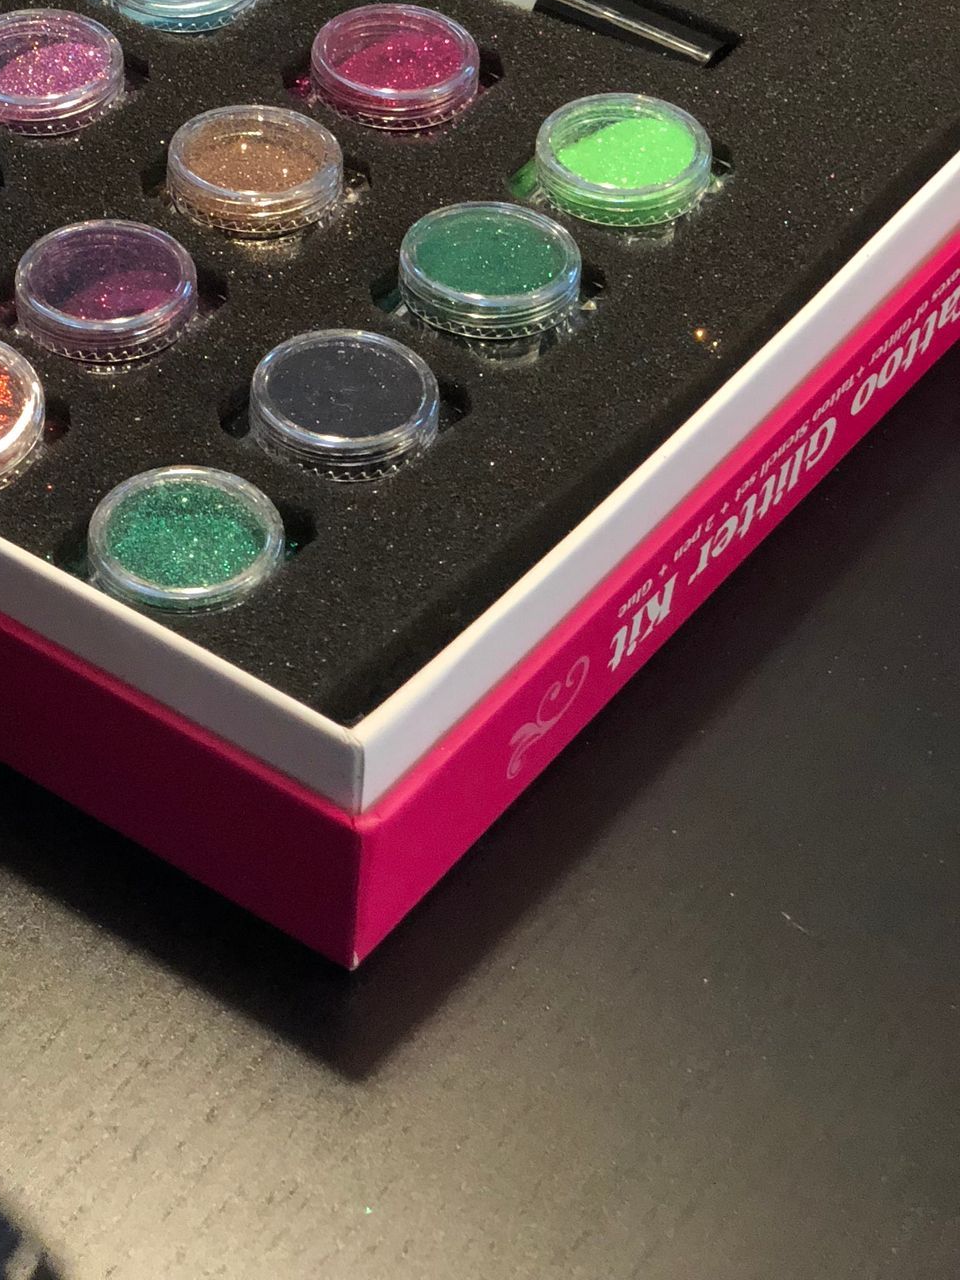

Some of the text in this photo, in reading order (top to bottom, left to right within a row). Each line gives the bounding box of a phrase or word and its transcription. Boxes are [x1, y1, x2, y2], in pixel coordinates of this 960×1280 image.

[931, 267, 960, 303] oxes
[912, 299, 929, 325] of
[868, 317, 913, 367] Glitter
[759, 419, 810, 478] Stencil
[687, 416, 838, 586] Glitter
[734, 471, 758, 502] set
[705, 513, 716, 533] 2
[673, 530, 702, 563] pen
[617, 578, 654, 618] Glue
[607, 572, 679, 673] Kit
